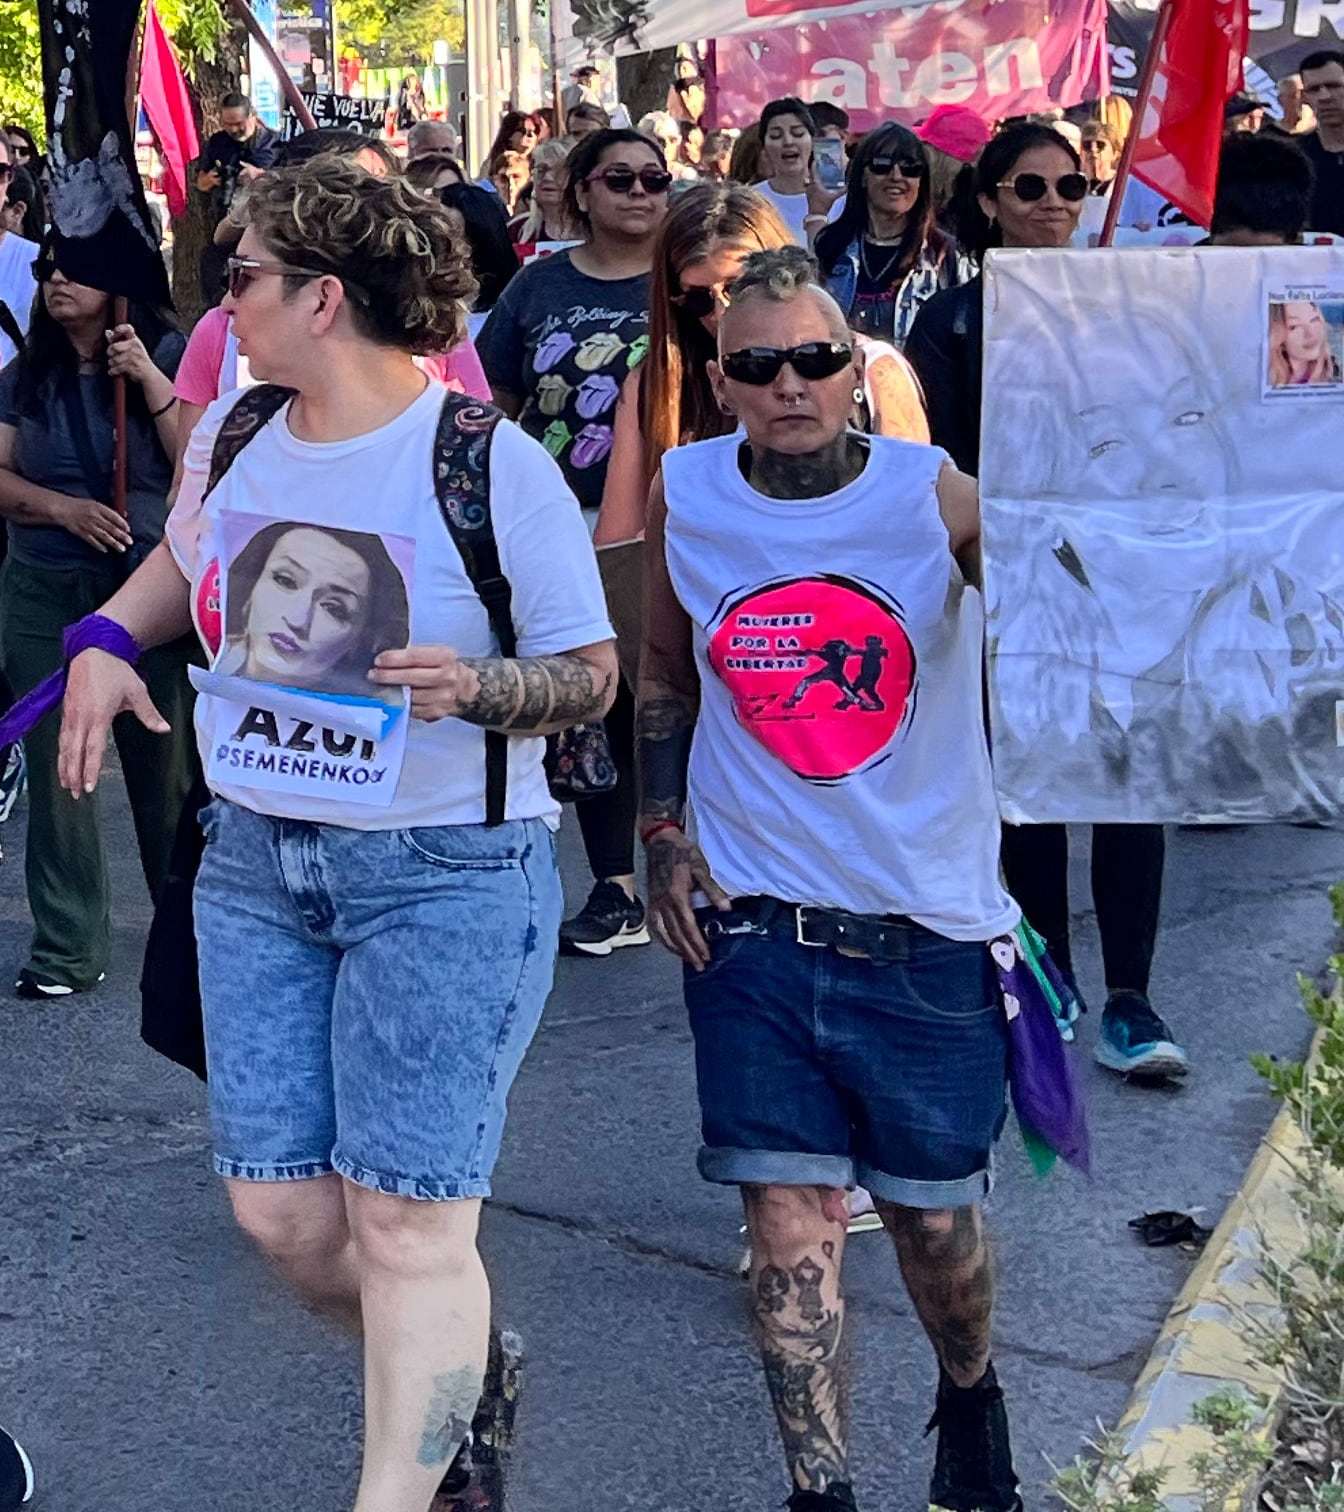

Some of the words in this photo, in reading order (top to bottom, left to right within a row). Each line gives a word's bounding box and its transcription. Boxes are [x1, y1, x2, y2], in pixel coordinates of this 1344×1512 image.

[812, 36, 1043, 109] aten
[567, 305, 634, 330] Rolling
[731, 637, 767, 649] POR
[776, 638, 799, 648] LA
